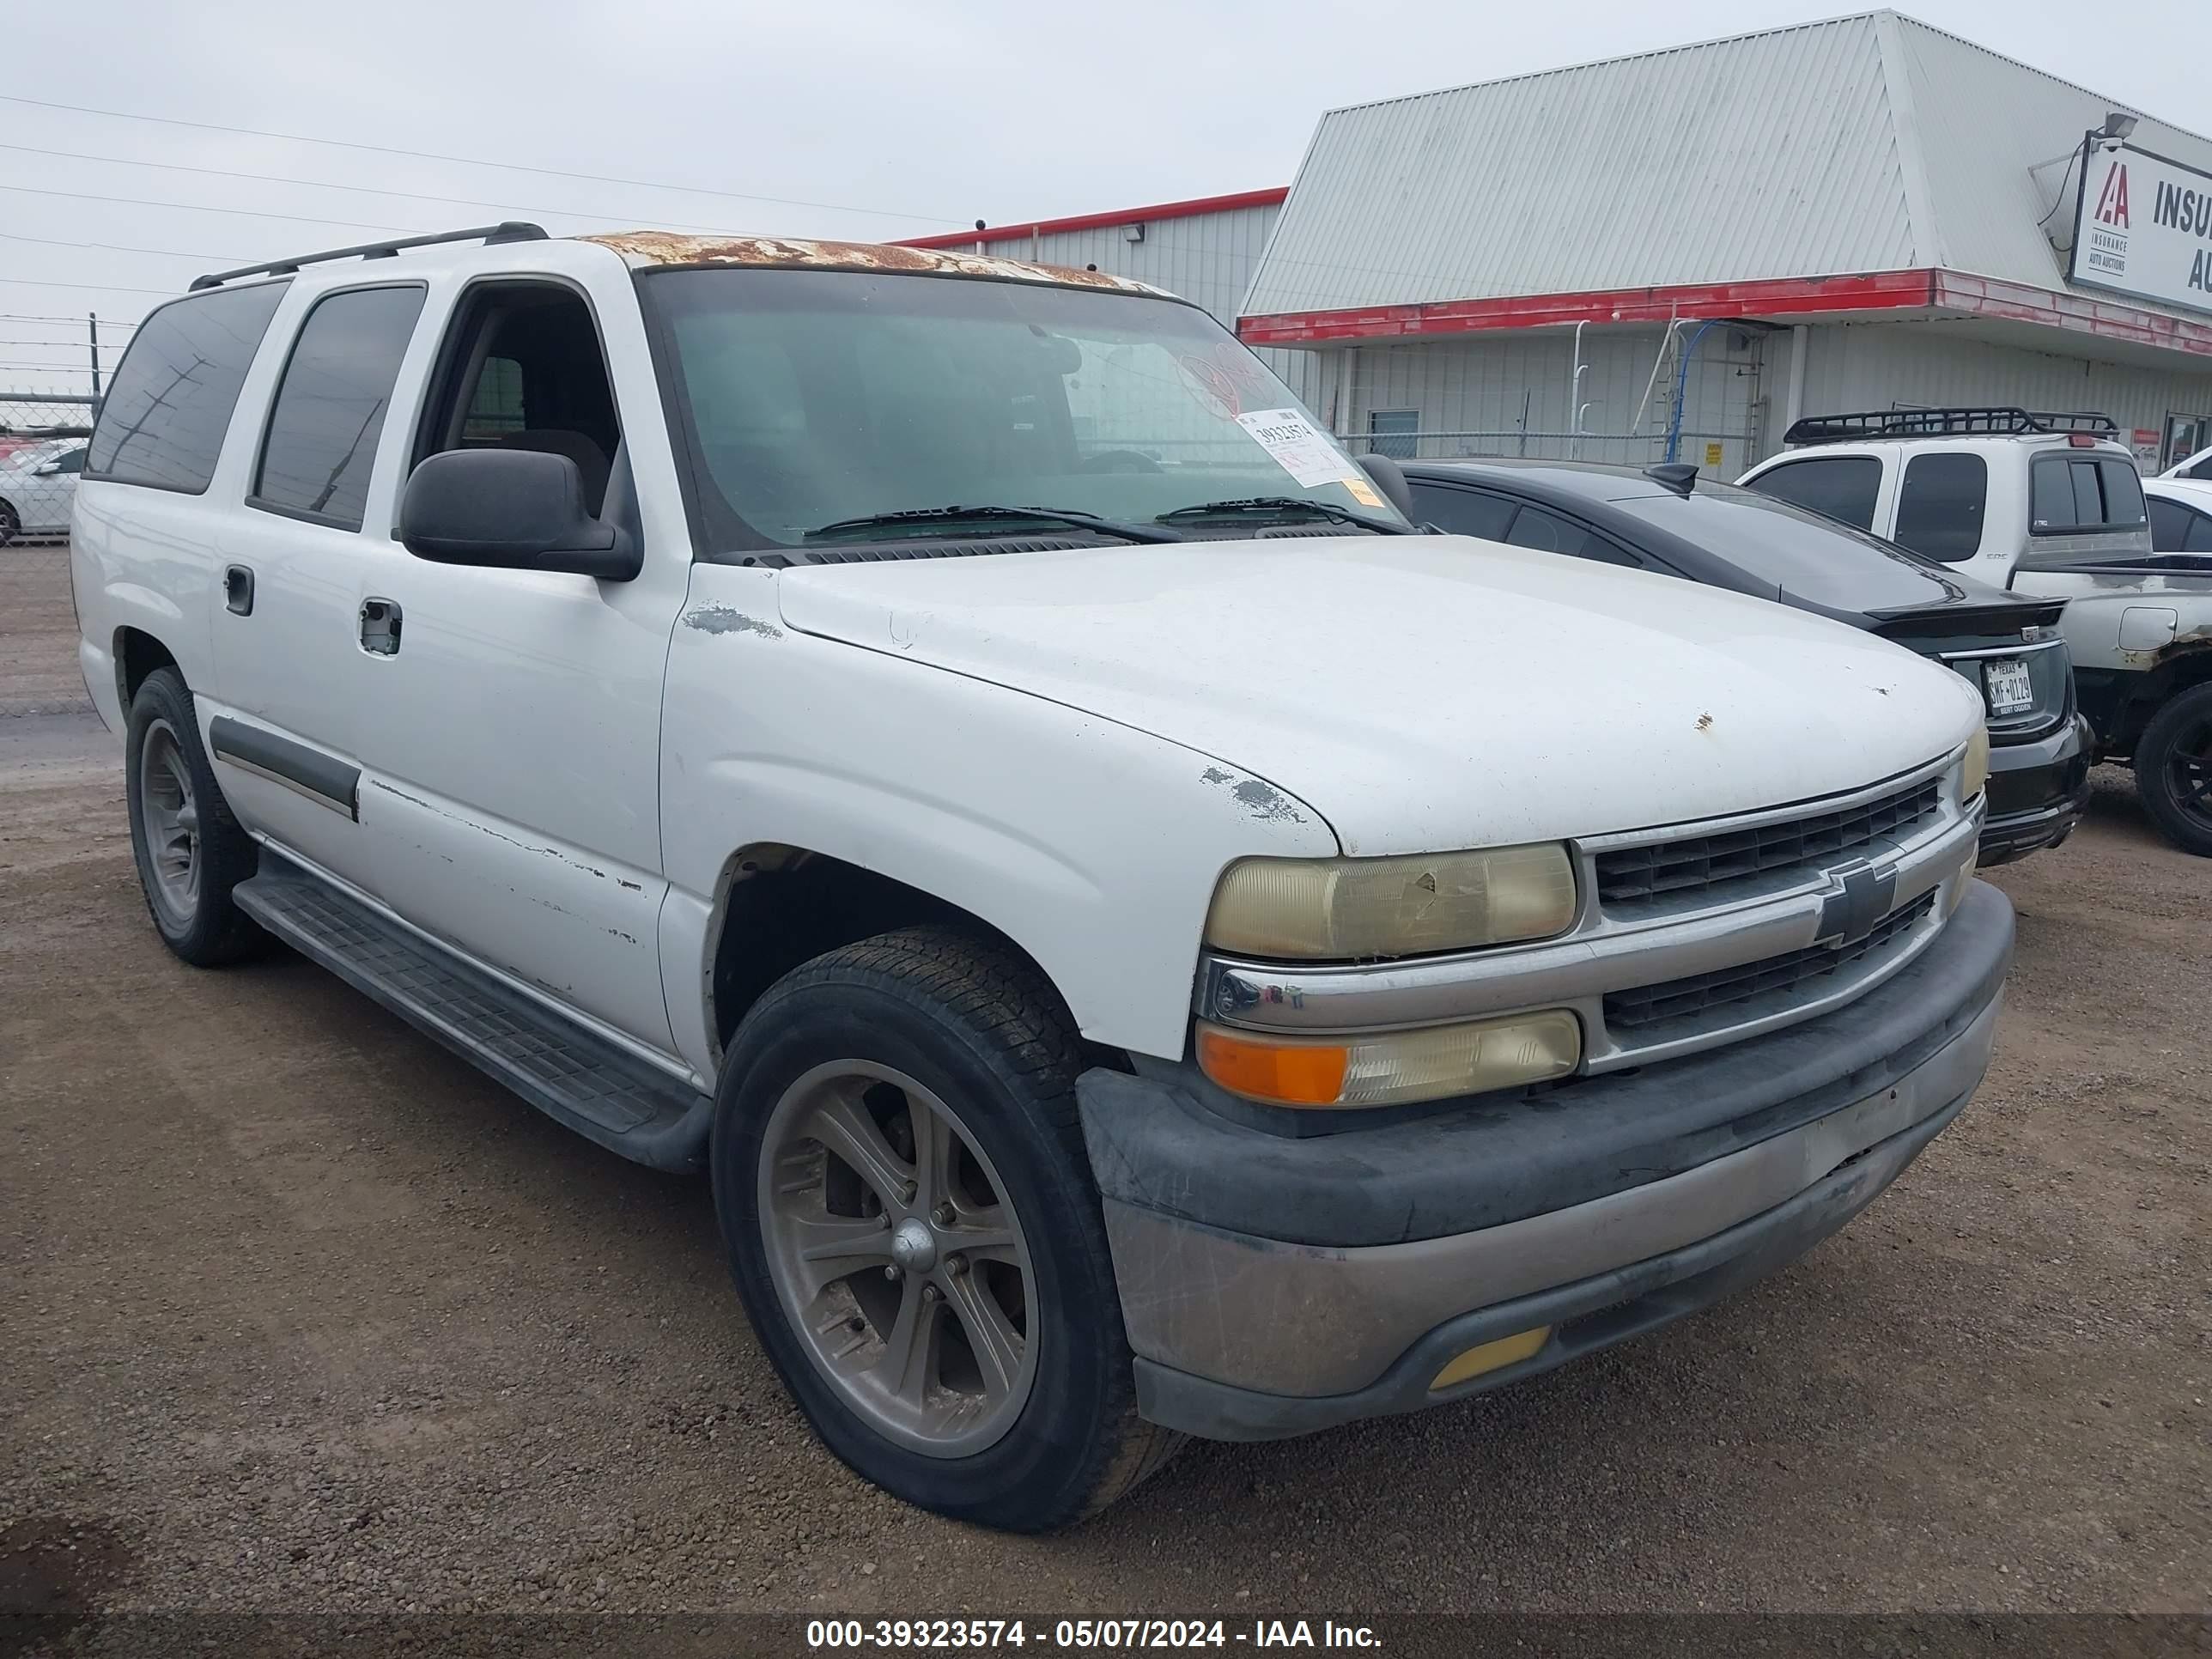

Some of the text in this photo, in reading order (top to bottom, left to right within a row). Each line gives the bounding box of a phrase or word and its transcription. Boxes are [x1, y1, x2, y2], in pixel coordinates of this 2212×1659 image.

[2154, 180, 2212, 240] INSU
[2091, 233, 2128, 252] INSURANCE
[2089, 252, 2125, 271] AUTO AUCTIONS
[1256, 424, 1314, 443] 39323574
[1997, 663, 2016, 676] TEXAS
